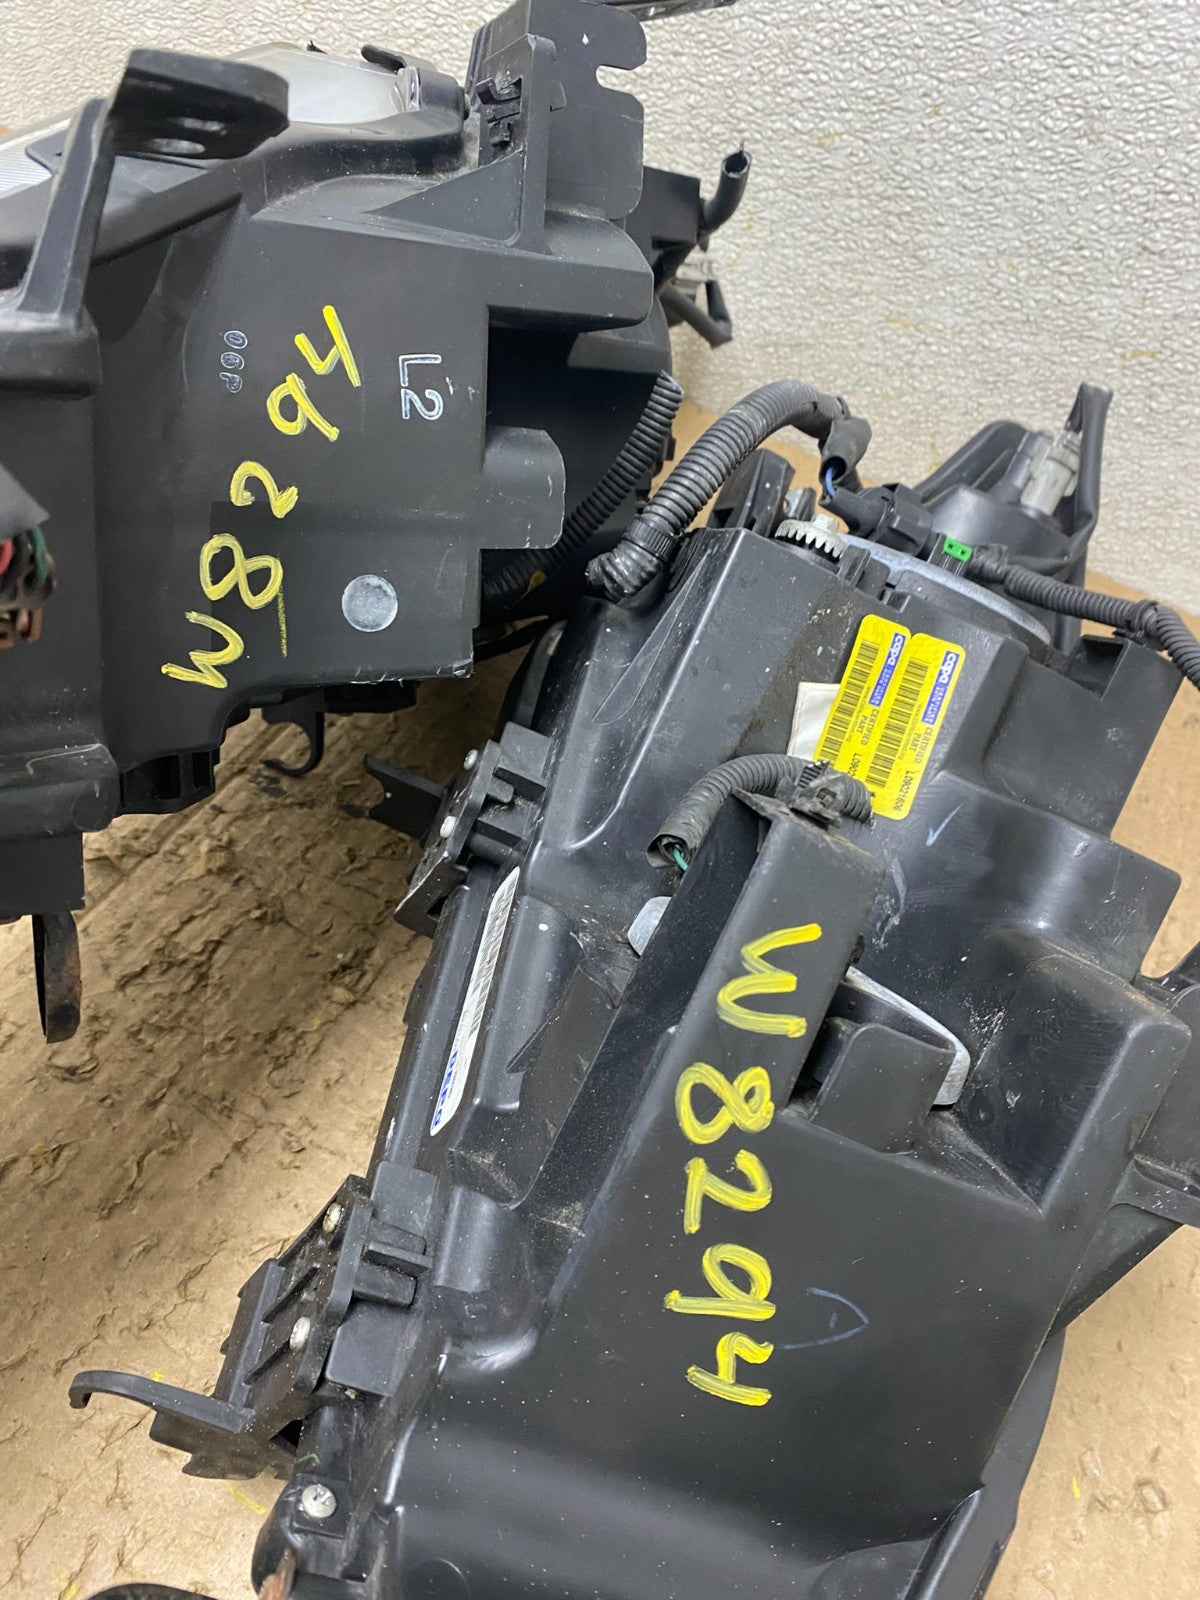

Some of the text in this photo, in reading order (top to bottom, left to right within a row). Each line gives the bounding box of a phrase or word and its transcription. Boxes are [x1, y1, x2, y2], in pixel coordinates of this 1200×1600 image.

[398, 353, 443, 422] L2
[161, 304, 362, 688] W8294
[856, 715, 868, 734] PART
[861, 710, 879, 745] CERTIFIED
[909, 733, 921, 751] PART
[916, 727, 933, 763] CERTIFIED
[847, 753, 861, 776] L0902
[664, 922, 824, 1408] W8294
